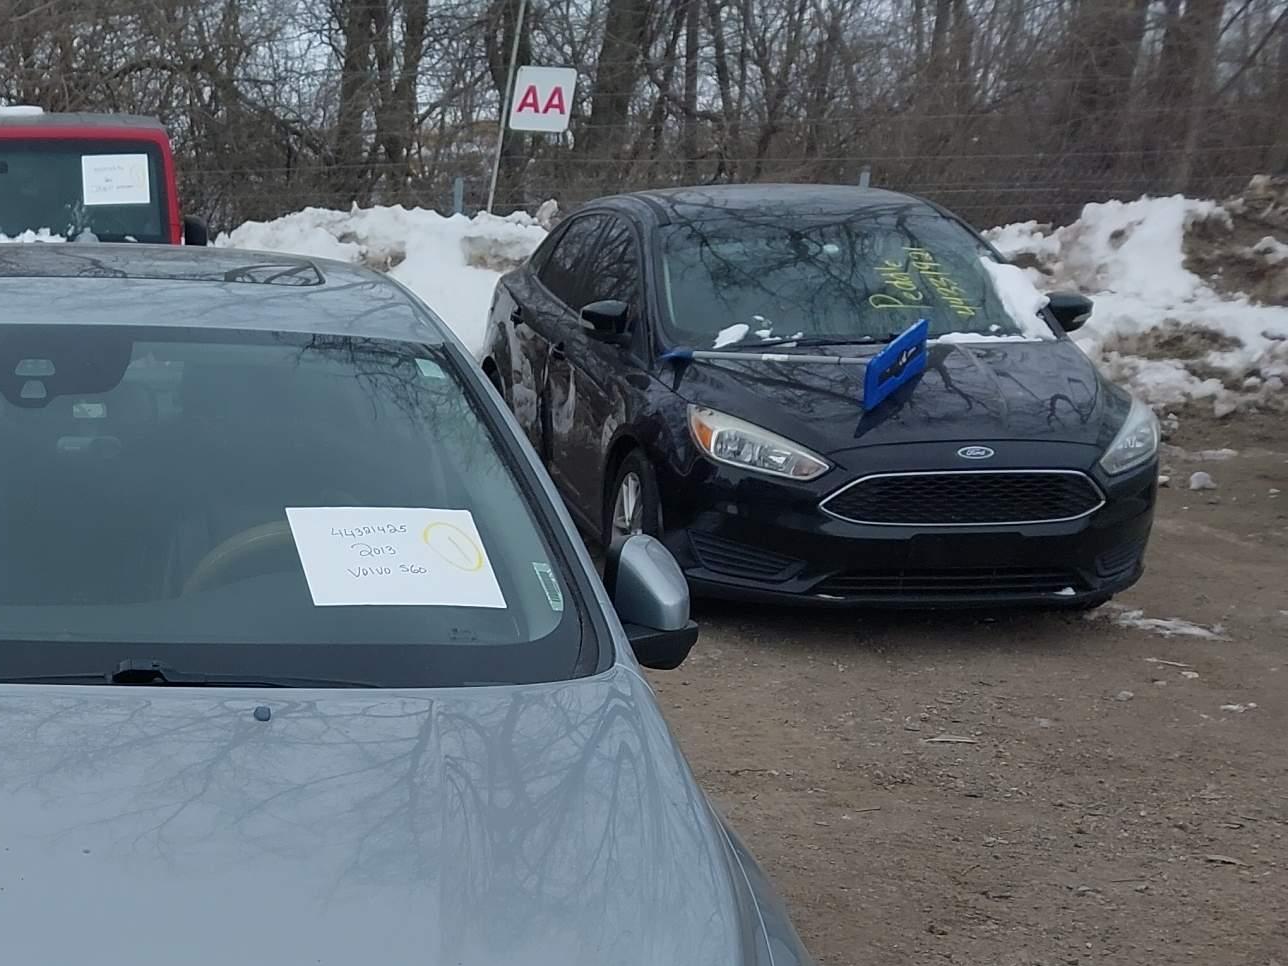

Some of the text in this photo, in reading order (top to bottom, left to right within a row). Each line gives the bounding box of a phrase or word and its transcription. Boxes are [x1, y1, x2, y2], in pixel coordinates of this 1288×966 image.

[516, 84, 566, 115] AA
[330, 524, 408, 539] 44321425
[350, 542, 397, 558] 2013
[398, 563, 428, 575] S60
